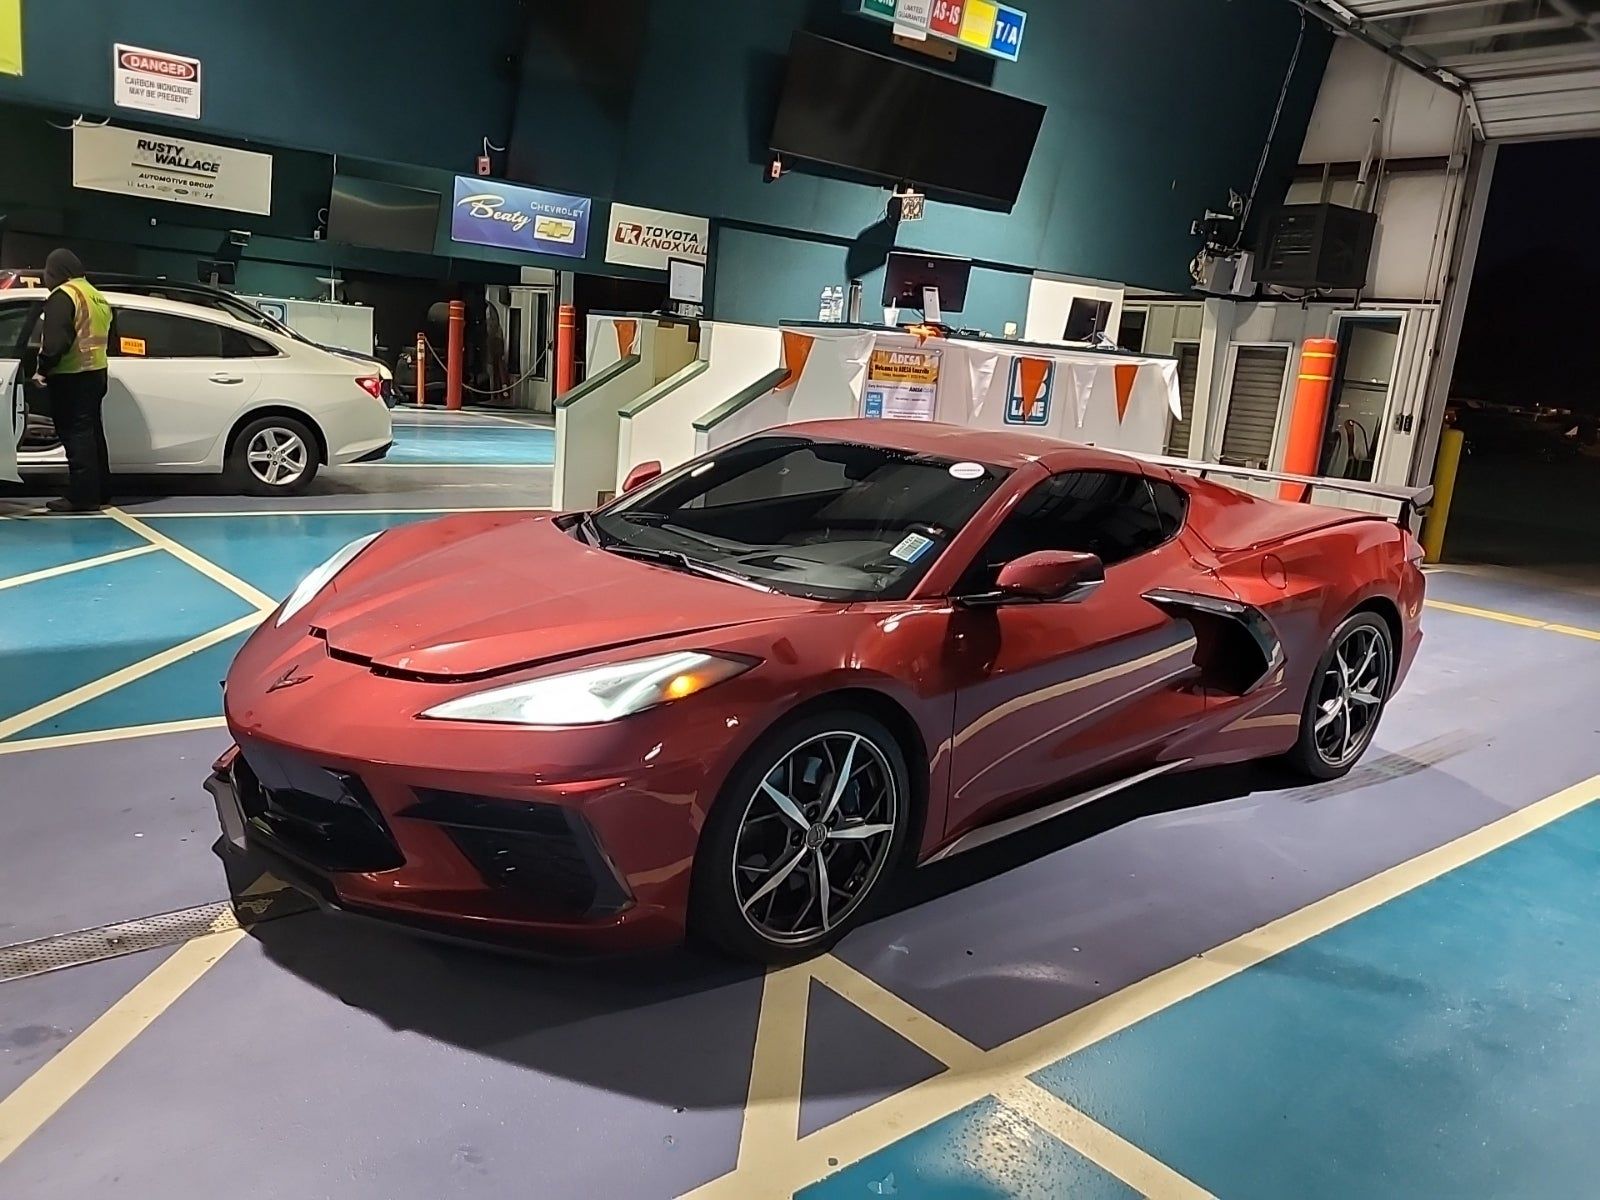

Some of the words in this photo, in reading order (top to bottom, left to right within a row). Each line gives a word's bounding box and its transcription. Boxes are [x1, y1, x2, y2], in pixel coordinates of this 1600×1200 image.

[995, 20, 1017, 46] T/A
[130, 55, 186, 76] DANGER
[125, 76, 155, 88] CARBON
[156, 82, 193, 96] MONOXIDE
[129, 87, 145, 96] MAY
[146, 89, 156, 98] BE
[157, 91, 189, 104] PRESENT
[137, 139, 185, 156] RUSTY
[155, 153, 221, 173] WALLACE
[138, 172, 188, 186] AUTOMOTIVE
[188, 180, 215, 189] GROUP
[457, 194, 533, 232] Beaty
[530, 201, 584, 218] CHEVROLET
[645, 226, 699, 243] TOYOTA
[889, 352, 922, 367] ADESA
